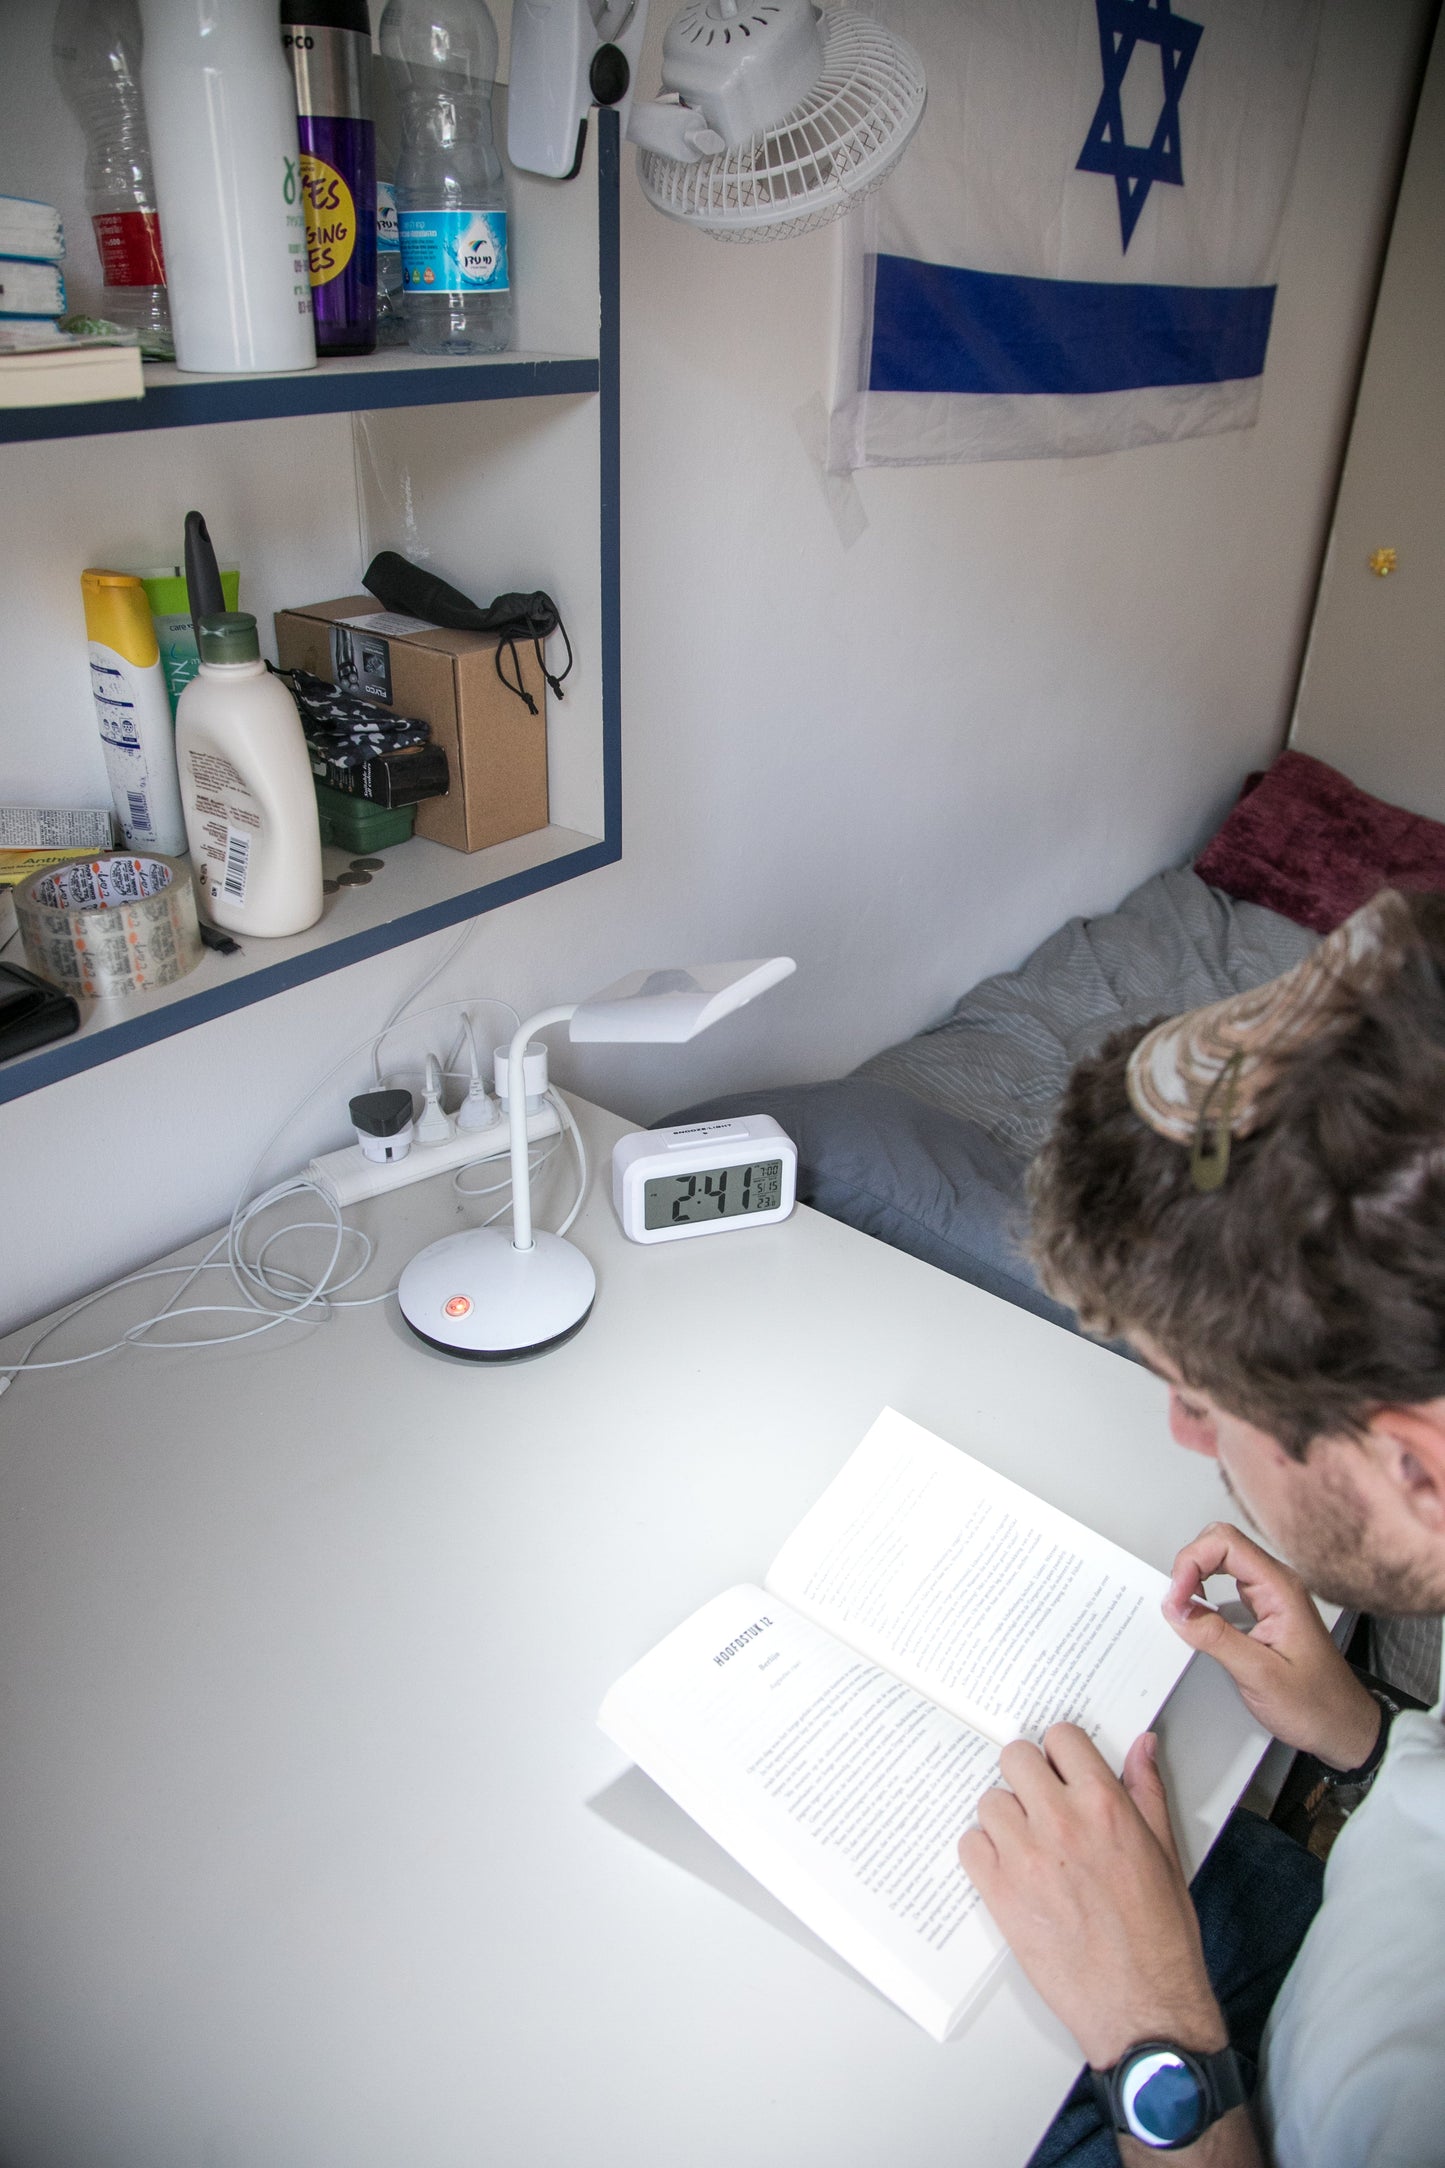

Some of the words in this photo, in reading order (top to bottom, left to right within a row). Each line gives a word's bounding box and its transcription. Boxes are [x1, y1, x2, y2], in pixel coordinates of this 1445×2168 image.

[365, 685, 387, 698] FLYCO
[760, 1165, 778, 1176] 7:00
[672, 1167, 752, 1221] 2:41
[713, 1624, 763, 1666] HOOFDSTUK
